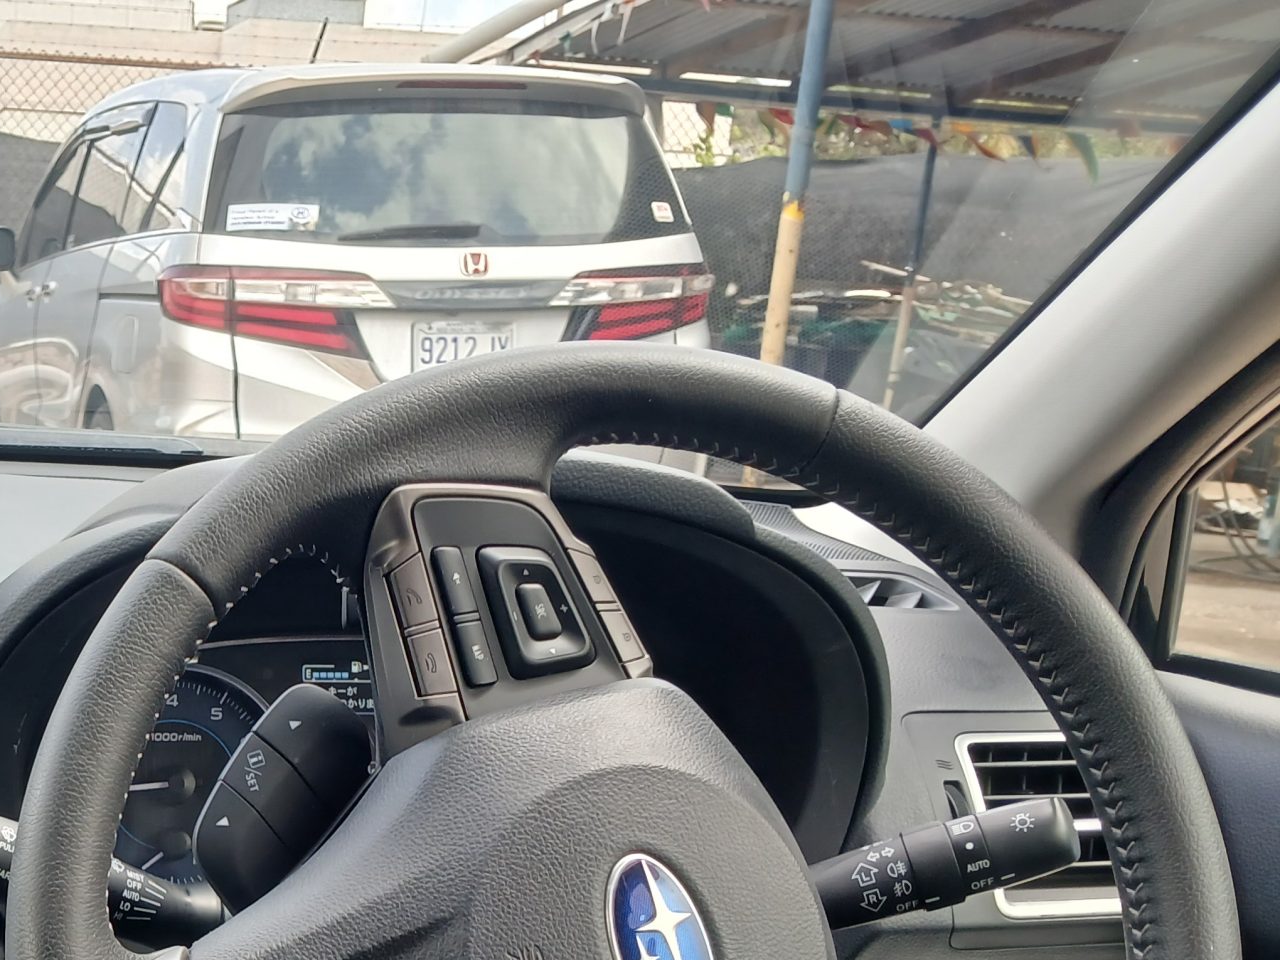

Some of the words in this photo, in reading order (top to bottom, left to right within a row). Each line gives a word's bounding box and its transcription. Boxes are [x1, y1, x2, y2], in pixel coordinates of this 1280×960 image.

[420, 336, 477, 364] 9212
[210, 707, 223, 720] 5
[966, 858, 990, 873] AUTO
[126, 878, 142, 890] OFF
[971, 876, 995, 890] OFF
[122, 888, 140, 902] AUTO
[119, 900, 131, 911] LO
[896, 900, 919, 912] OFF
